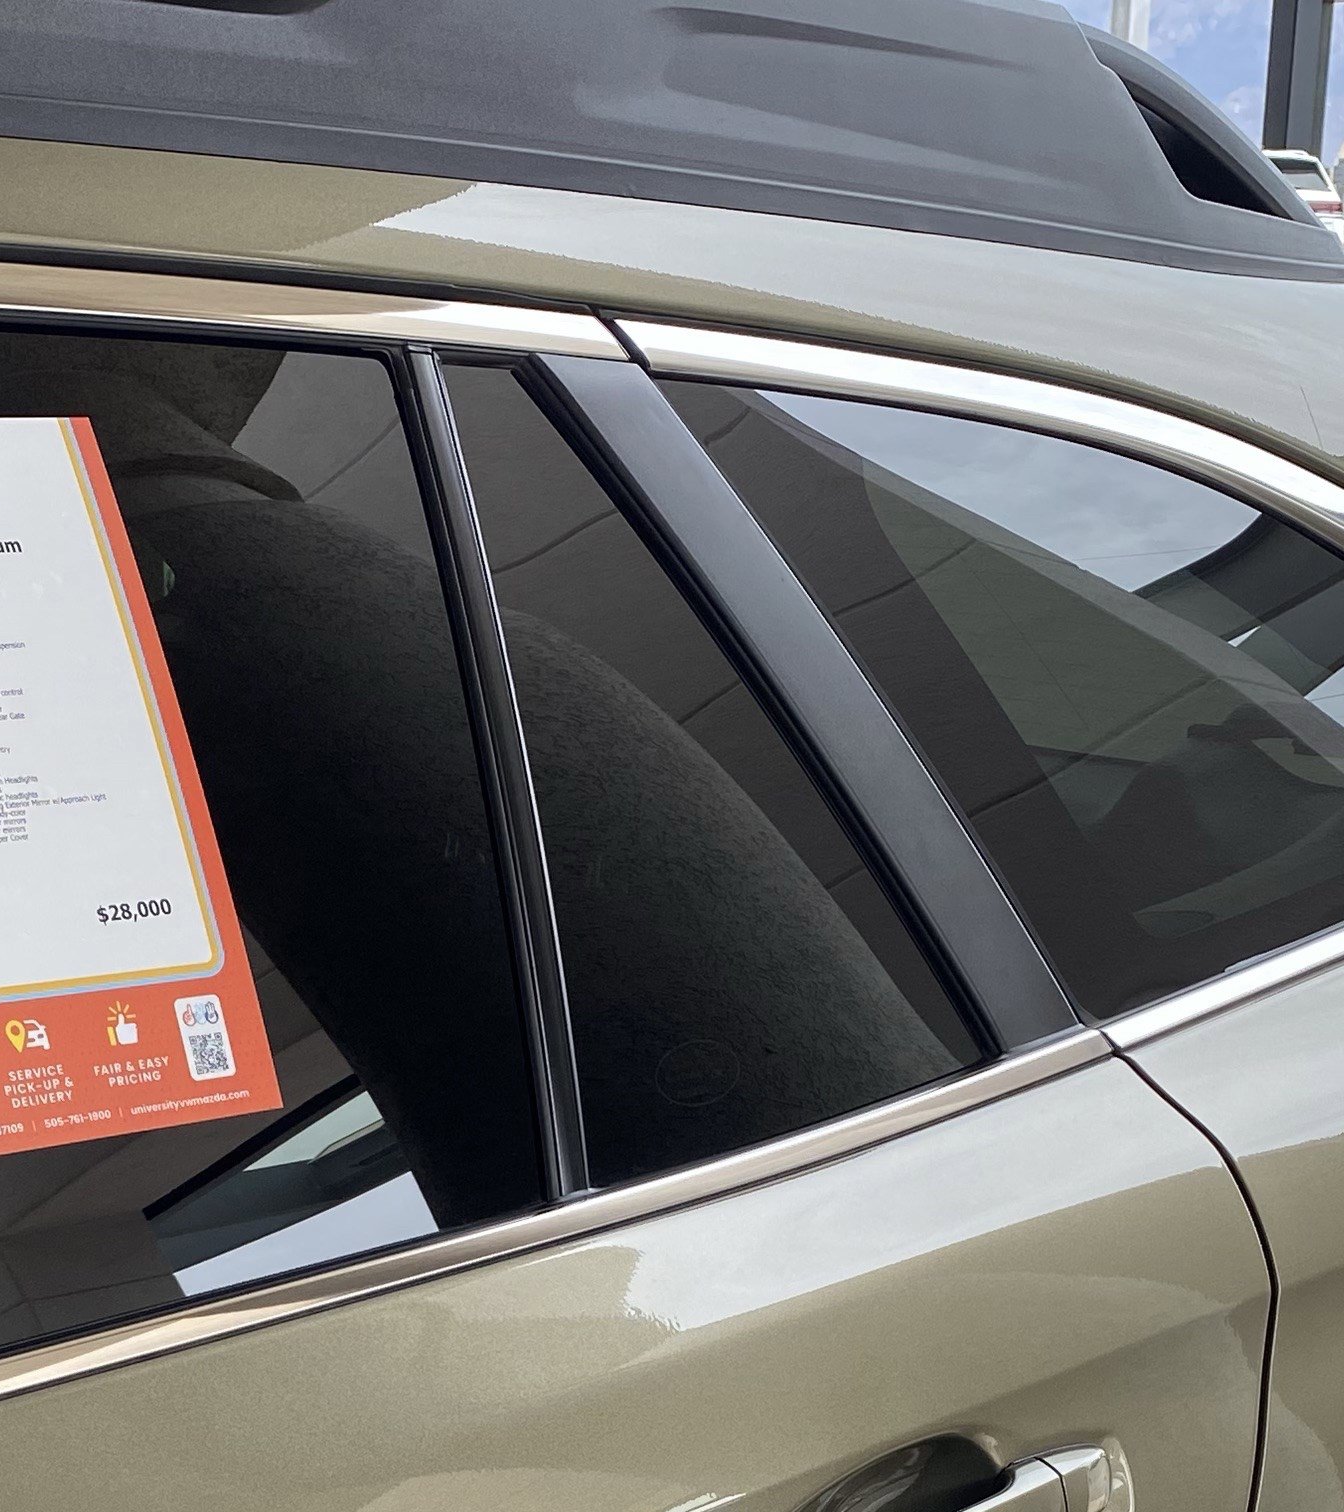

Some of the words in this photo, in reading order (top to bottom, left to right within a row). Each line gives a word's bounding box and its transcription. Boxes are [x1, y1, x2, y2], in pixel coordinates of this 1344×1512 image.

[94, 897, 174, 926] $28,000
[7, 1063, 64, 1082] SERVICE
[92, 1062, 123, 1077] FAIR
[124, 1060, 135, 1072] &
[137, 1055, 171, 1070] EASY
[3, 1078, 61, 1097] PICK-UP
[63, 1076, 74, 1087] &
[107, 1069, 162, 1088] PRICING
[10, 1089, 74, 1109] DELIVERY
[43, 1108, 112, 1129] 505-761-1900
